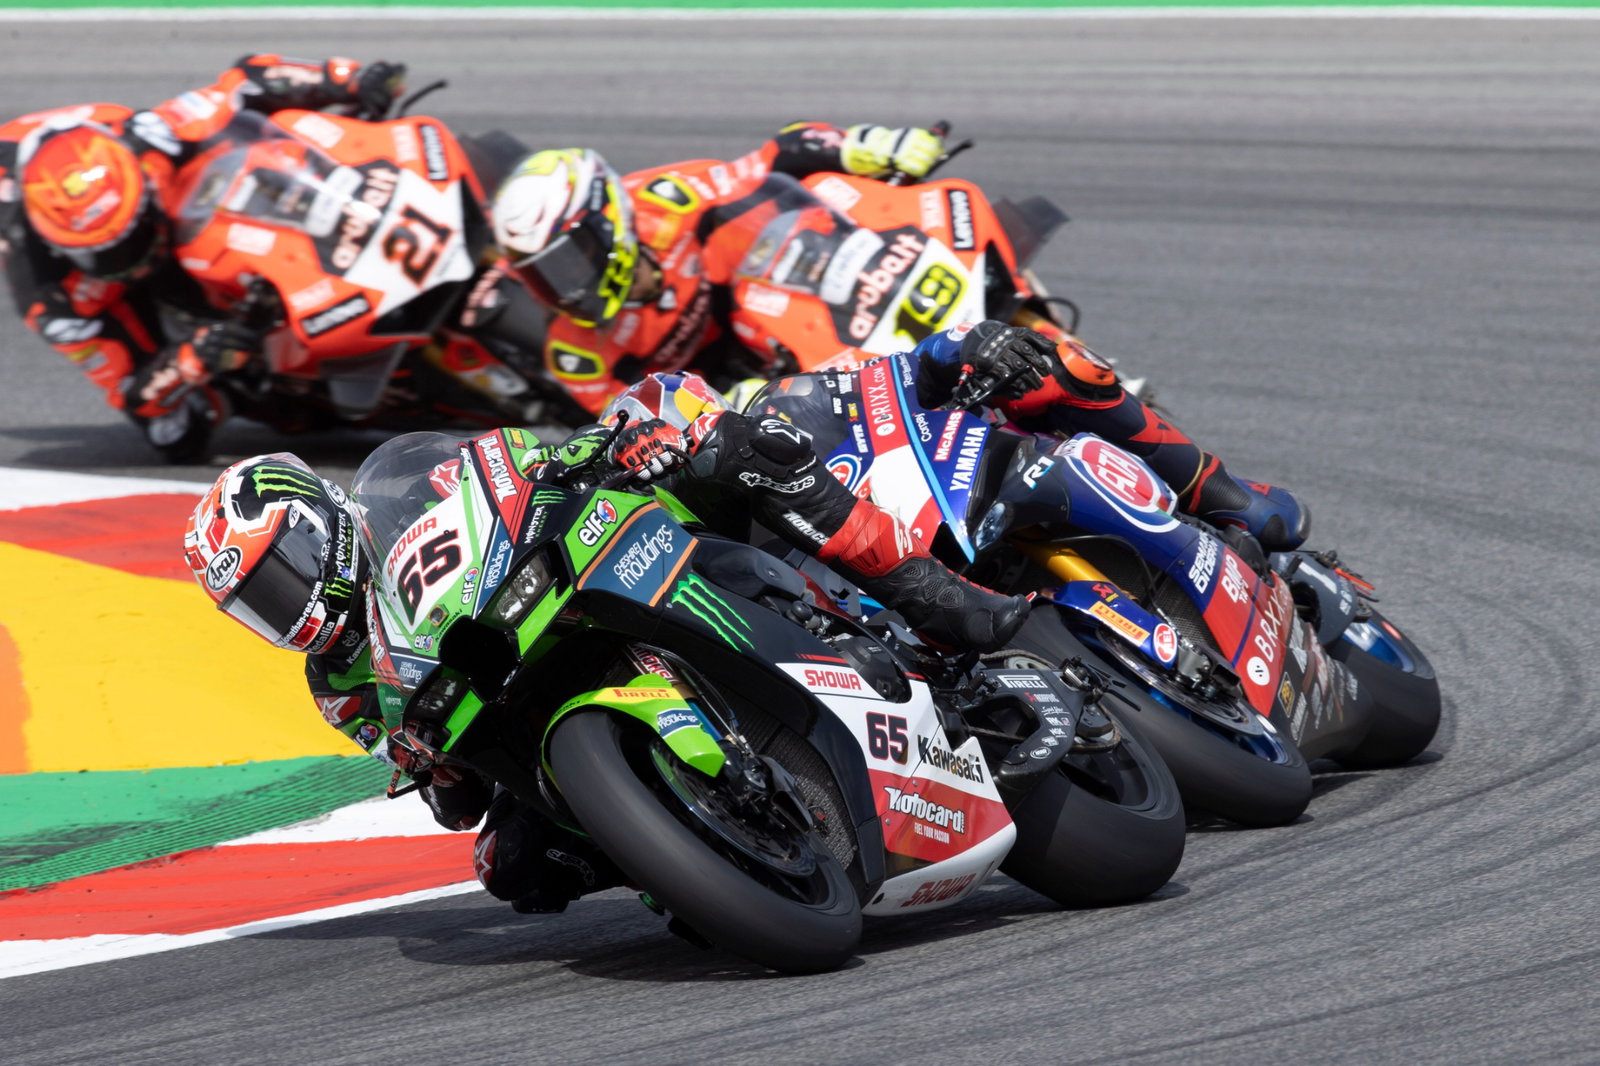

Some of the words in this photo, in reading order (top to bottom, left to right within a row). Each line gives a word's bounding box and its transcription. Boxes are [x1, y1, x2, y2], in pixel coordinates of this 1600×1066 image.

[381, 204, 455, 288] 21
[894, 262, 968, 345] 19
[914, 413, 932, 442] Corpay
[935, 411, 962, 460] McAMS
[949, 426, 987, 491] YAMAHA
[1023, 456, 1055, 489] R1
[1097, 447, 1140, 500] PATA
[387, 517, 437, 577] SHOWA
[579, 512, 603, 547] elf
[782, 509, 830, 545] Motoca
[208, 549, 237, 587] Arai
[397, 528, 462, 625] 65
[619, 524, 673, 590] mouldings
[613, 689, 670, 698] PIRELLI
[804, 670, 861, 690] SHOWA
[997, 675, 1048, 688] PIRELLI
[866, 711, 909, 765] 65
[918, 734, 984, 784] Kawasaki
[884, 786, 962, 834] Motocard
